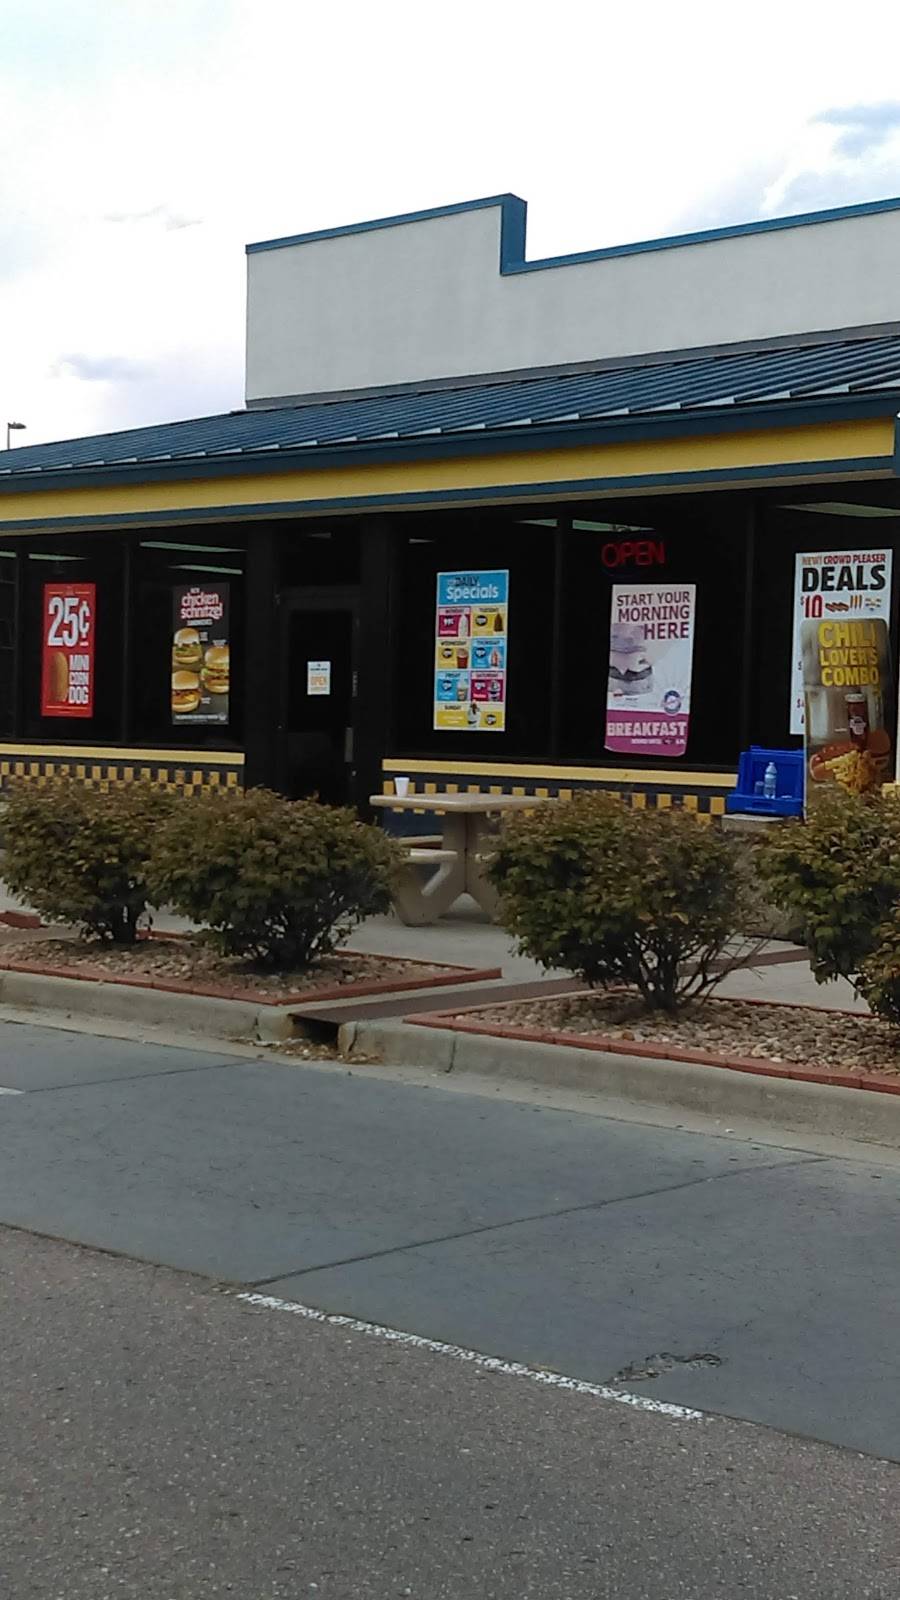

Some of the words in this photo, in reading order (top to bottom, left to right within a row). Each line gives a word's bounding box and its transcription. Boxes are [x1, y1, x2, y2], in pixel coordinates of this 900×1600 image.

[602, 541, 666, 567] OPEN
[823, 555, 851, 565] CROWD
[852, 553, 886, 564] PLEASER
[455, 576, 480, 587] DAILY
[801, 564, 886, 592] DEALS
[446, 583, 499, 602] Specials
[616, 593, 654, 607] START
[657, 591, 690, 604] YOUR
[618, 605, 690, 622] MORNING
[800, 594, 823, 618] $10
[47, 596, 90, 647] 25¢
[643, 621, 690, 640] HERE
[818, 621, 877, 648] CHILI
[69, 654, 90, 671] MINI
[69, 671, 89, 686] CORN
[821, 667, 880, 686] COMBO
[68, 686, 89, 705] DOG
[607, 721, 687, 737] BREAKFAST
